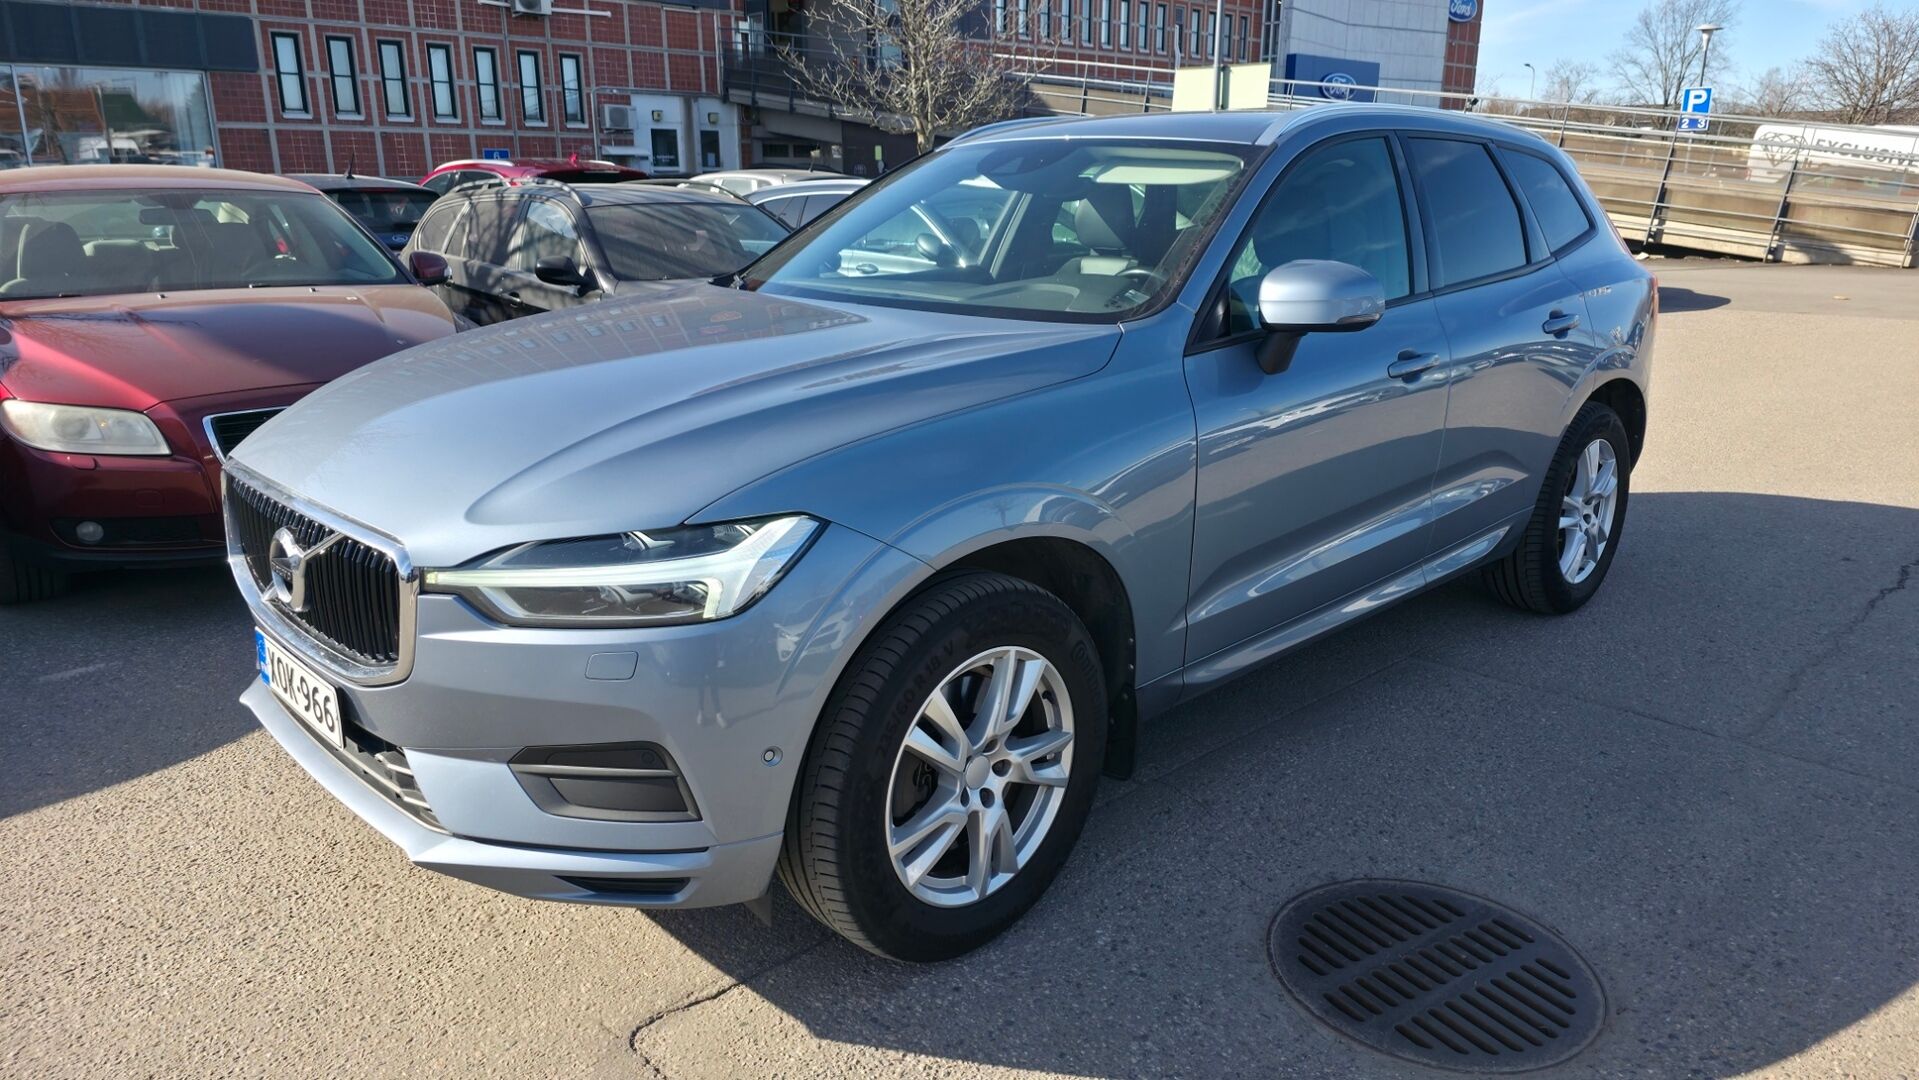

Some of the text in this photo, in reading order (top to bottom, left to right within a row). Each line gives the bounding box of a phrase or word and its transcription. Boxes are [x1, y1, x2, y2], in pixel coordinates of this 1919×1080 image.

[1450, 0, 1473, 17] Ford
[1687, 89, 1708, 113] P
[1681, 118, 1706, 129] 2 3
[267, 645, 336, 734] XOK-966
